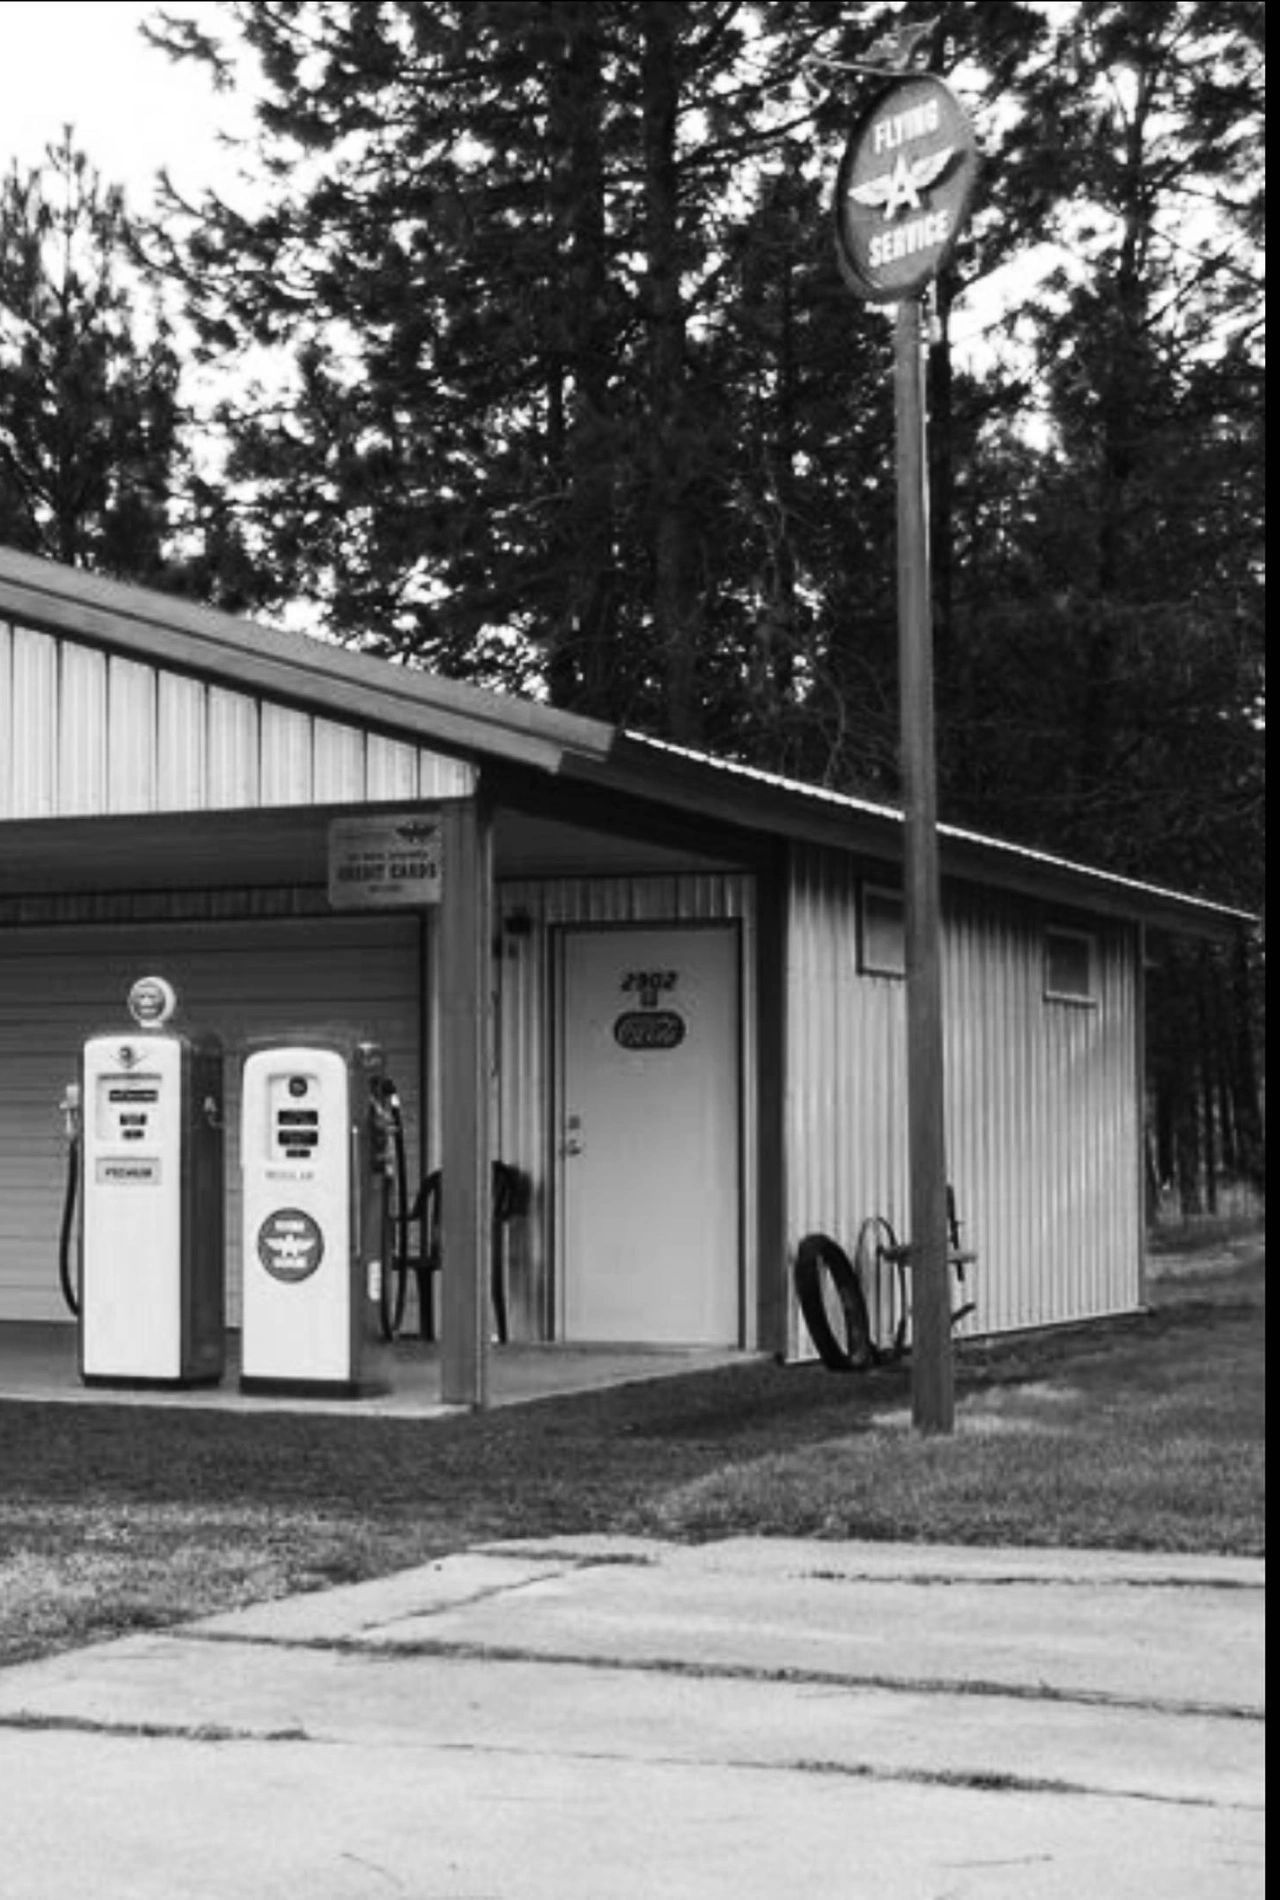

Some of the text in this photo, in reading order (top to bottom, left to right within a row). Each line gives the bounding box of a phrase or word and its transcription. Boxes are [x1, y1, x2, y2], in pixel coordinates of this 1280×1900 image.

[873, 100, 939, 155] FLYING
[868, 208, 950, 269] SERVICE
[390, 861, 438, 880] CARDS
